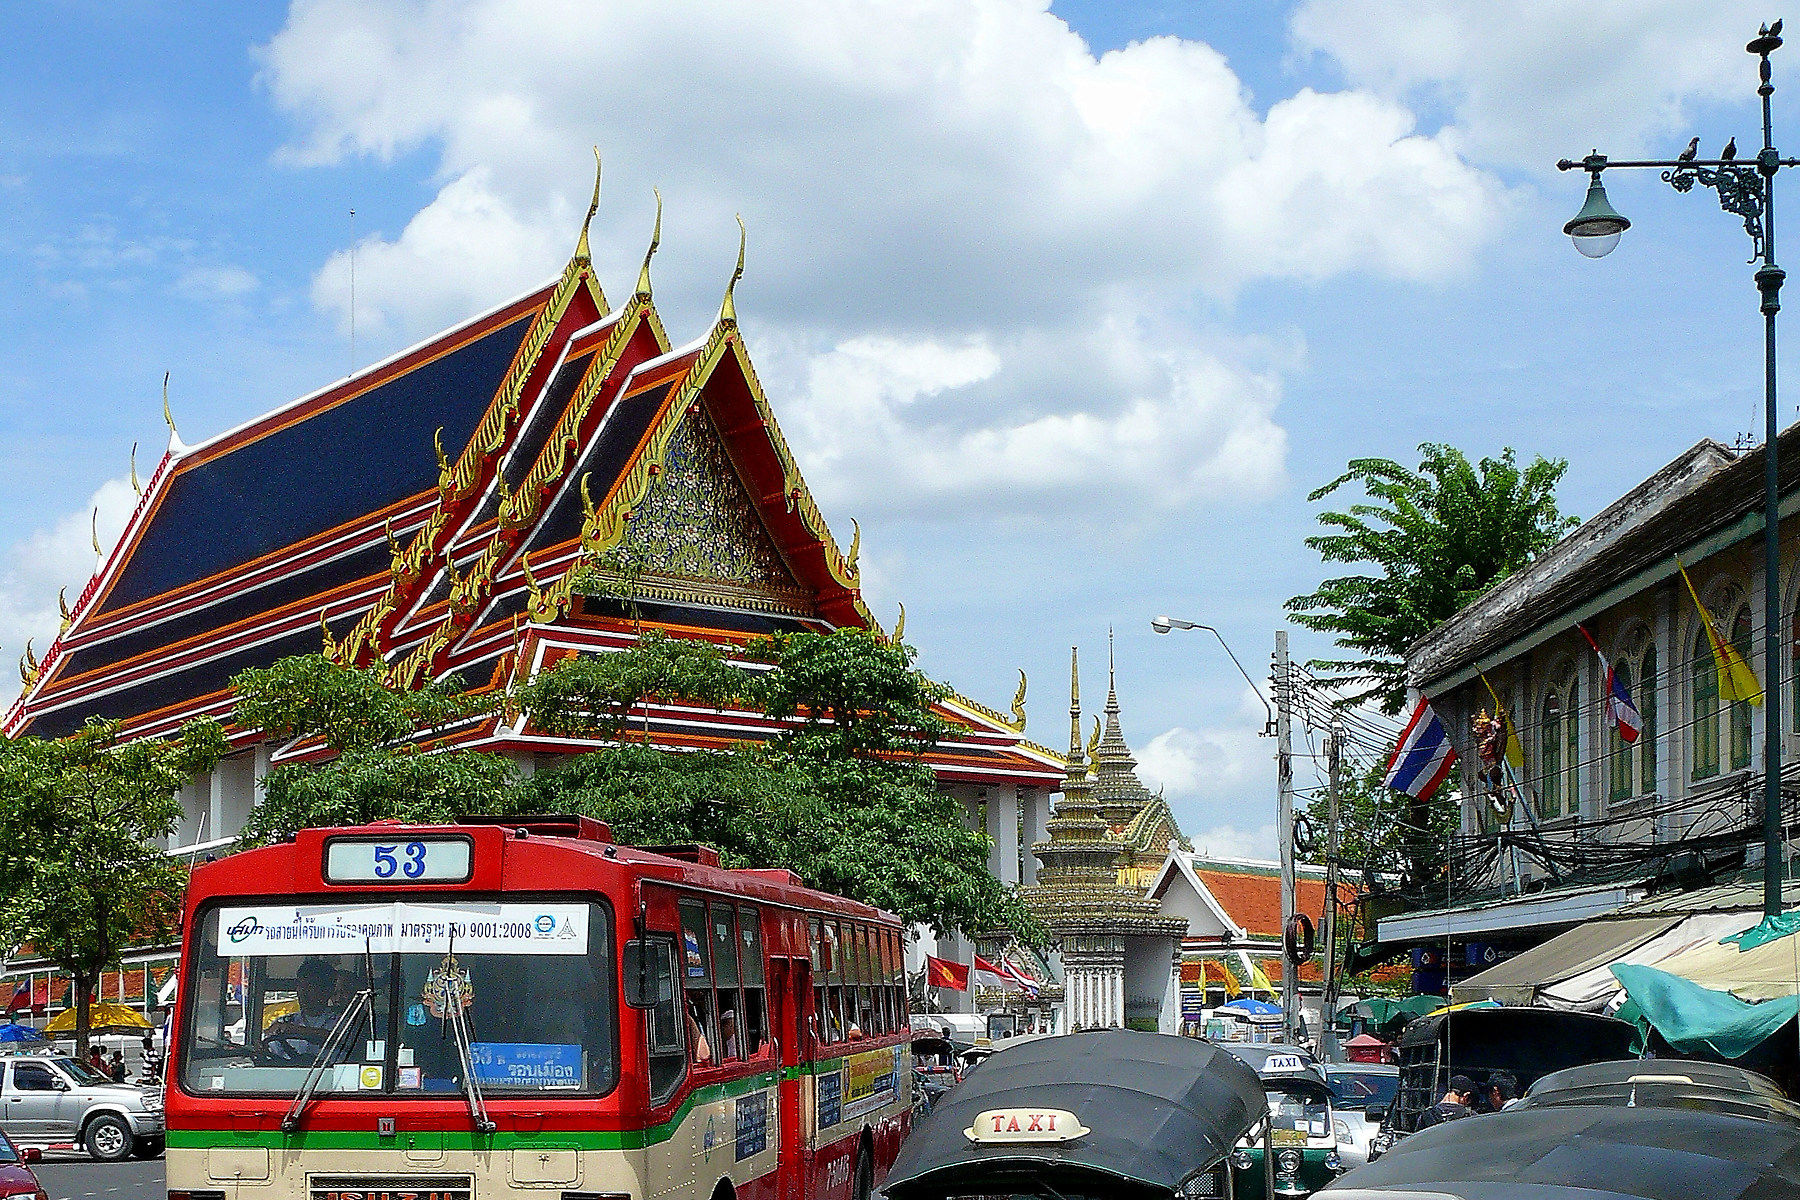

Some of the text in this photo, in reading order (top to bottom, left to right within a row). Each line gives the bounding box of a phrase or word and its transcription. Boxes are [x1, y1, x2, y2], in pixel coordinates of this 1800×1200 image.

[374, 842, 426, 878] 53
[470, 922, 532, 939] 9001:2008
[1271, 1058, 1297, 1068] TAXI
[991, 1115, 1057, 1133] TAXI
